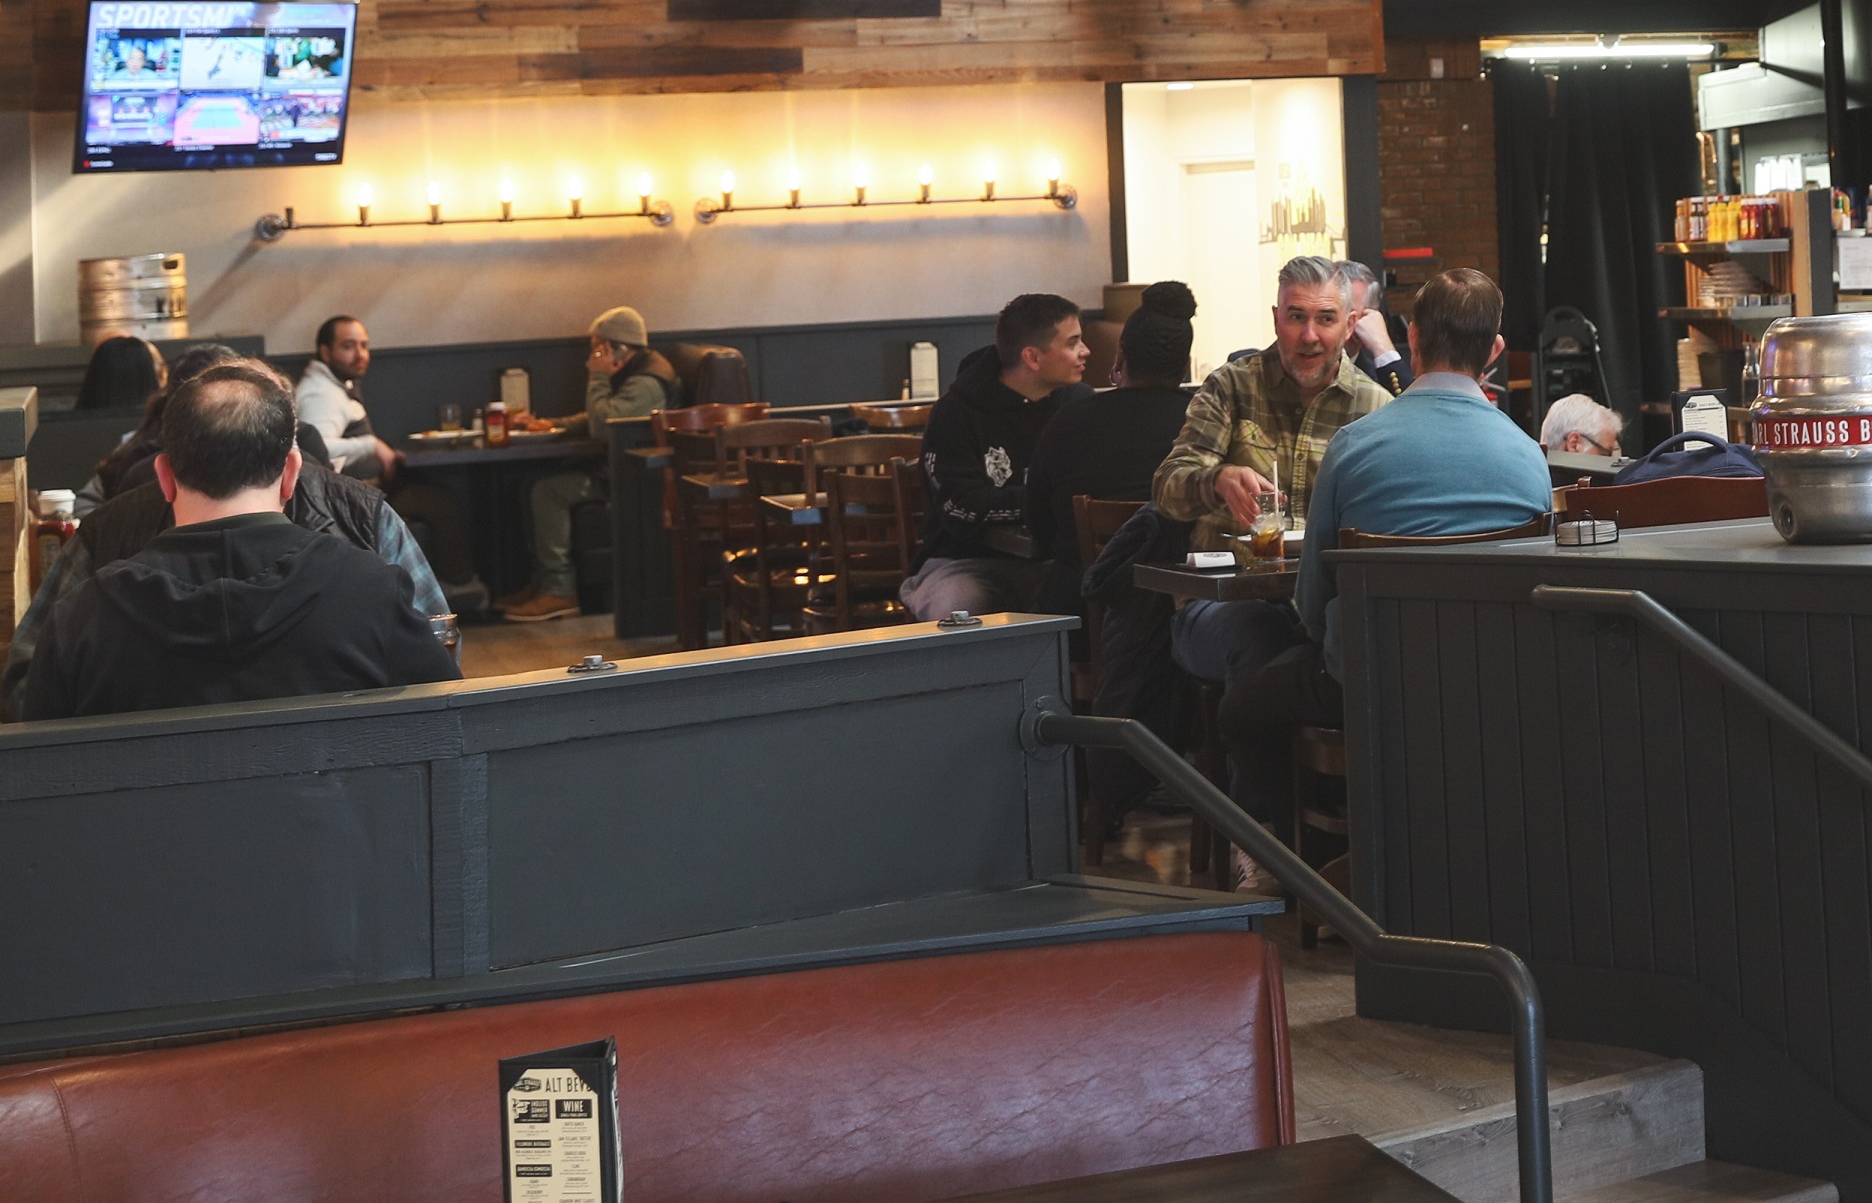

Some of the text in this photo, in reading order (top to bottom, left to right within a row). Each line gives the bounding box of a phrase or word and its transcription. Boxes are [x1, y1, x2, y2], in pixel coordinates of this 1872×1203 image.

[1752, 422, 1770, 445] ARL
[1774, 419, 1850, 445] STRAUSS
[545, 1077, 562, 1093] ALT
[563, 1100, 584, 1112] WINE
